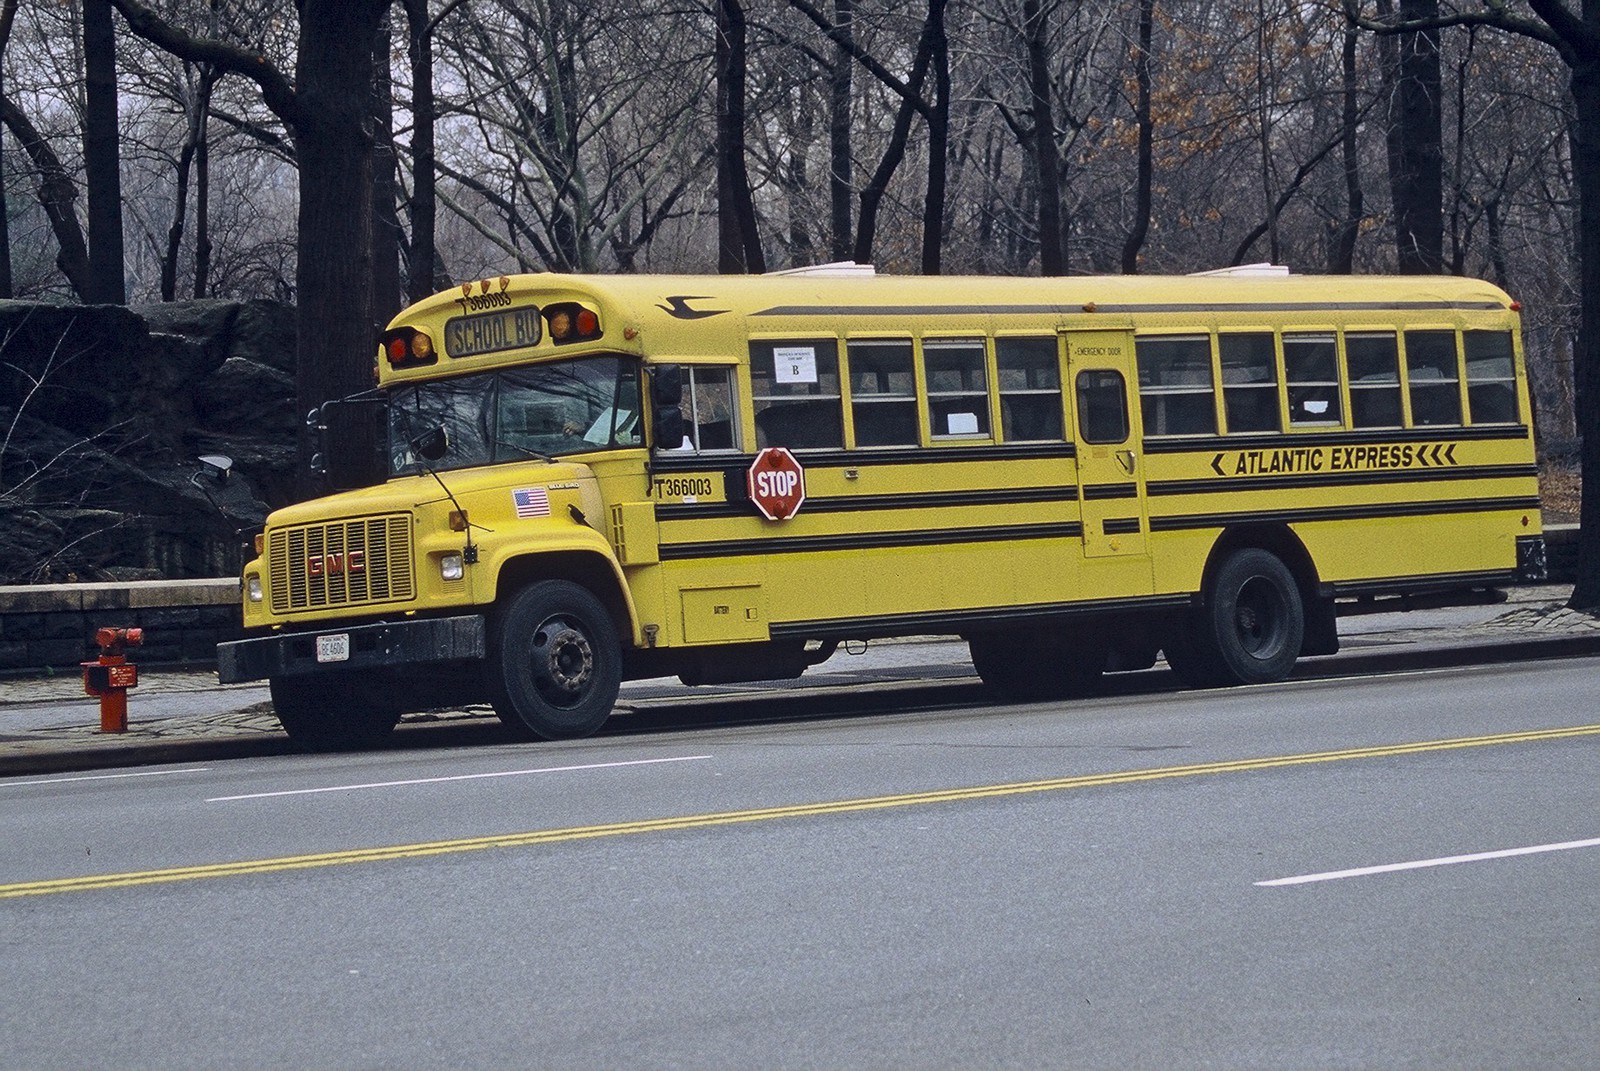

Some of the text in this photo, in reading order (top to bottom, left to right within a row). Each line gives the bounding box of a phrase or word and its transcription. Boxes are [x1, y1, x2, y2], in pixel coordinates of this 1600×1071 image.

[454, 291, 511, 315] T366003
[454, 314, 512, 353] SCHOOL
[1077, 347, 1121, 356] EMERGENCY DOOR
[792, 364, 799, 375] B
[1235, 445, 1413, 475] ATLANTIC EXPRESS
[654, 478, 712, 499] T366003
[757, 470, 798, 498] STOP
[308, 550, 365, 577] GMC
